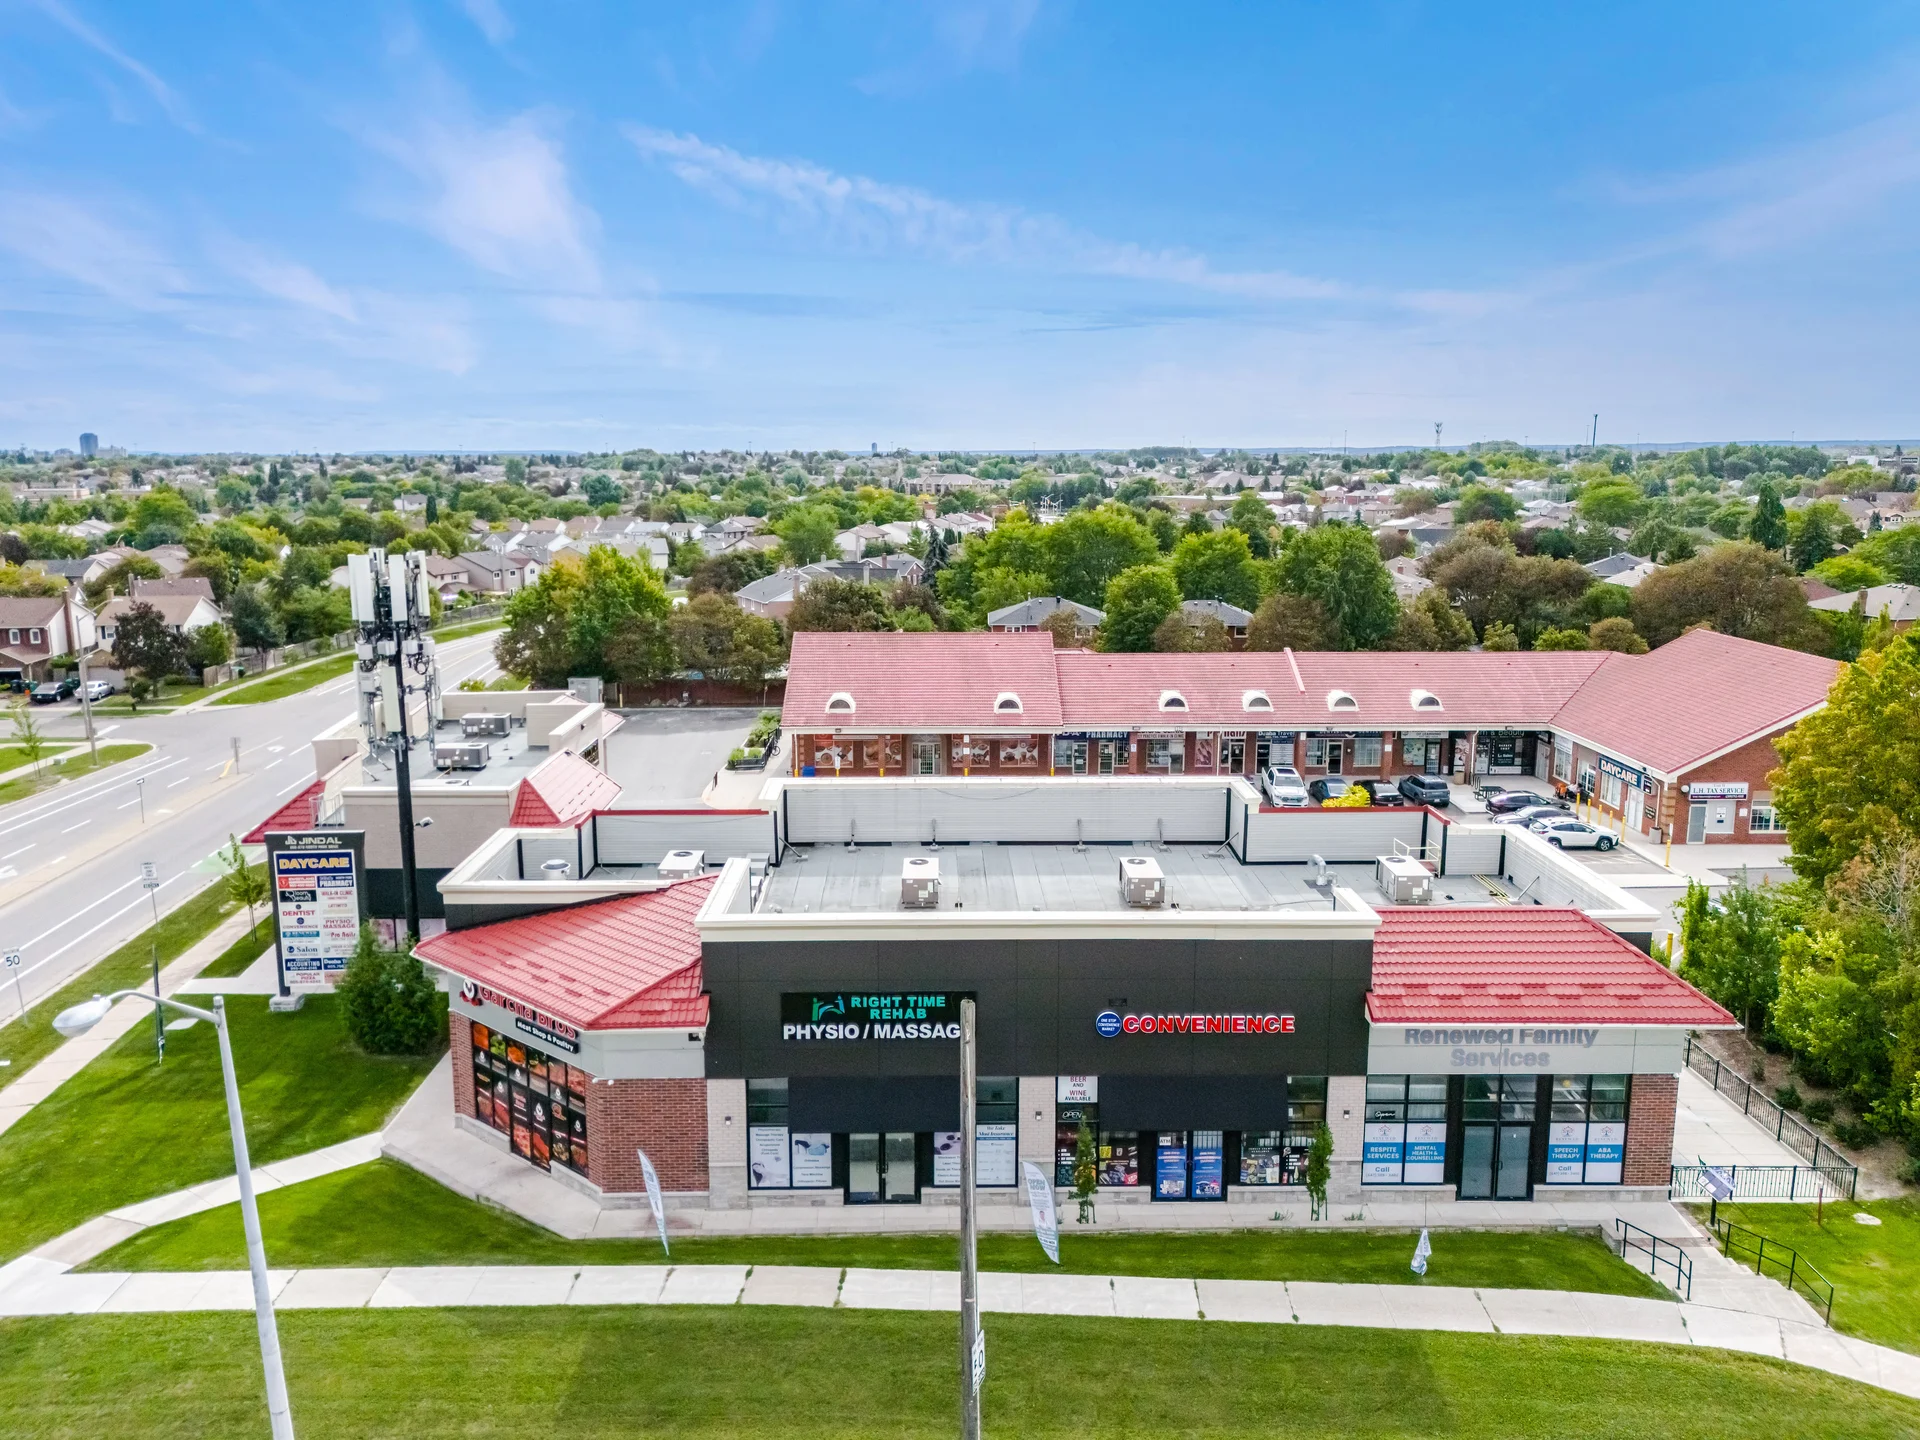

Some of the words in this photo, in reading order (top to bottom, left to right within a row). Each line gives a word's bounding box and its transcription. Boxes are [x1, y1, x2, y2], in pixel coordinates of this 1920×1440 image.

[1601, 760, 1638, 785] DAYCARE
[298, 836, 342, 845] JINDAL
[279, 857, 350, 869] DAYCARE
[320, 880, 353, 888] PHARMACY
[6, 955, 20, 967] 50
[850, 996, 902, 1008] RIGHT
[907, 996, 946, 1007] TIME
[870, 1008, 926, 1020] REHAB
[1122, 1015, 1296, 1033] CONVENIENCE
[517, 1021, 532, 1032] Meat
[532, 1027, 546, 1040] Shop
[547, 1034, 552, 1042] &
[552, 1037, 574, 1052] Poultry
[783, 1024, 860, 1040] PHYSIO
[874, 1024, 961, 1039] MASSAG
[1404, 1028, 1514, 1044] Renewed
[1518, 1028, 1600, 1048] Family
[1450, 1048, 1550, 1067] Services
[1375, 1111, 1396, 1120] Open
